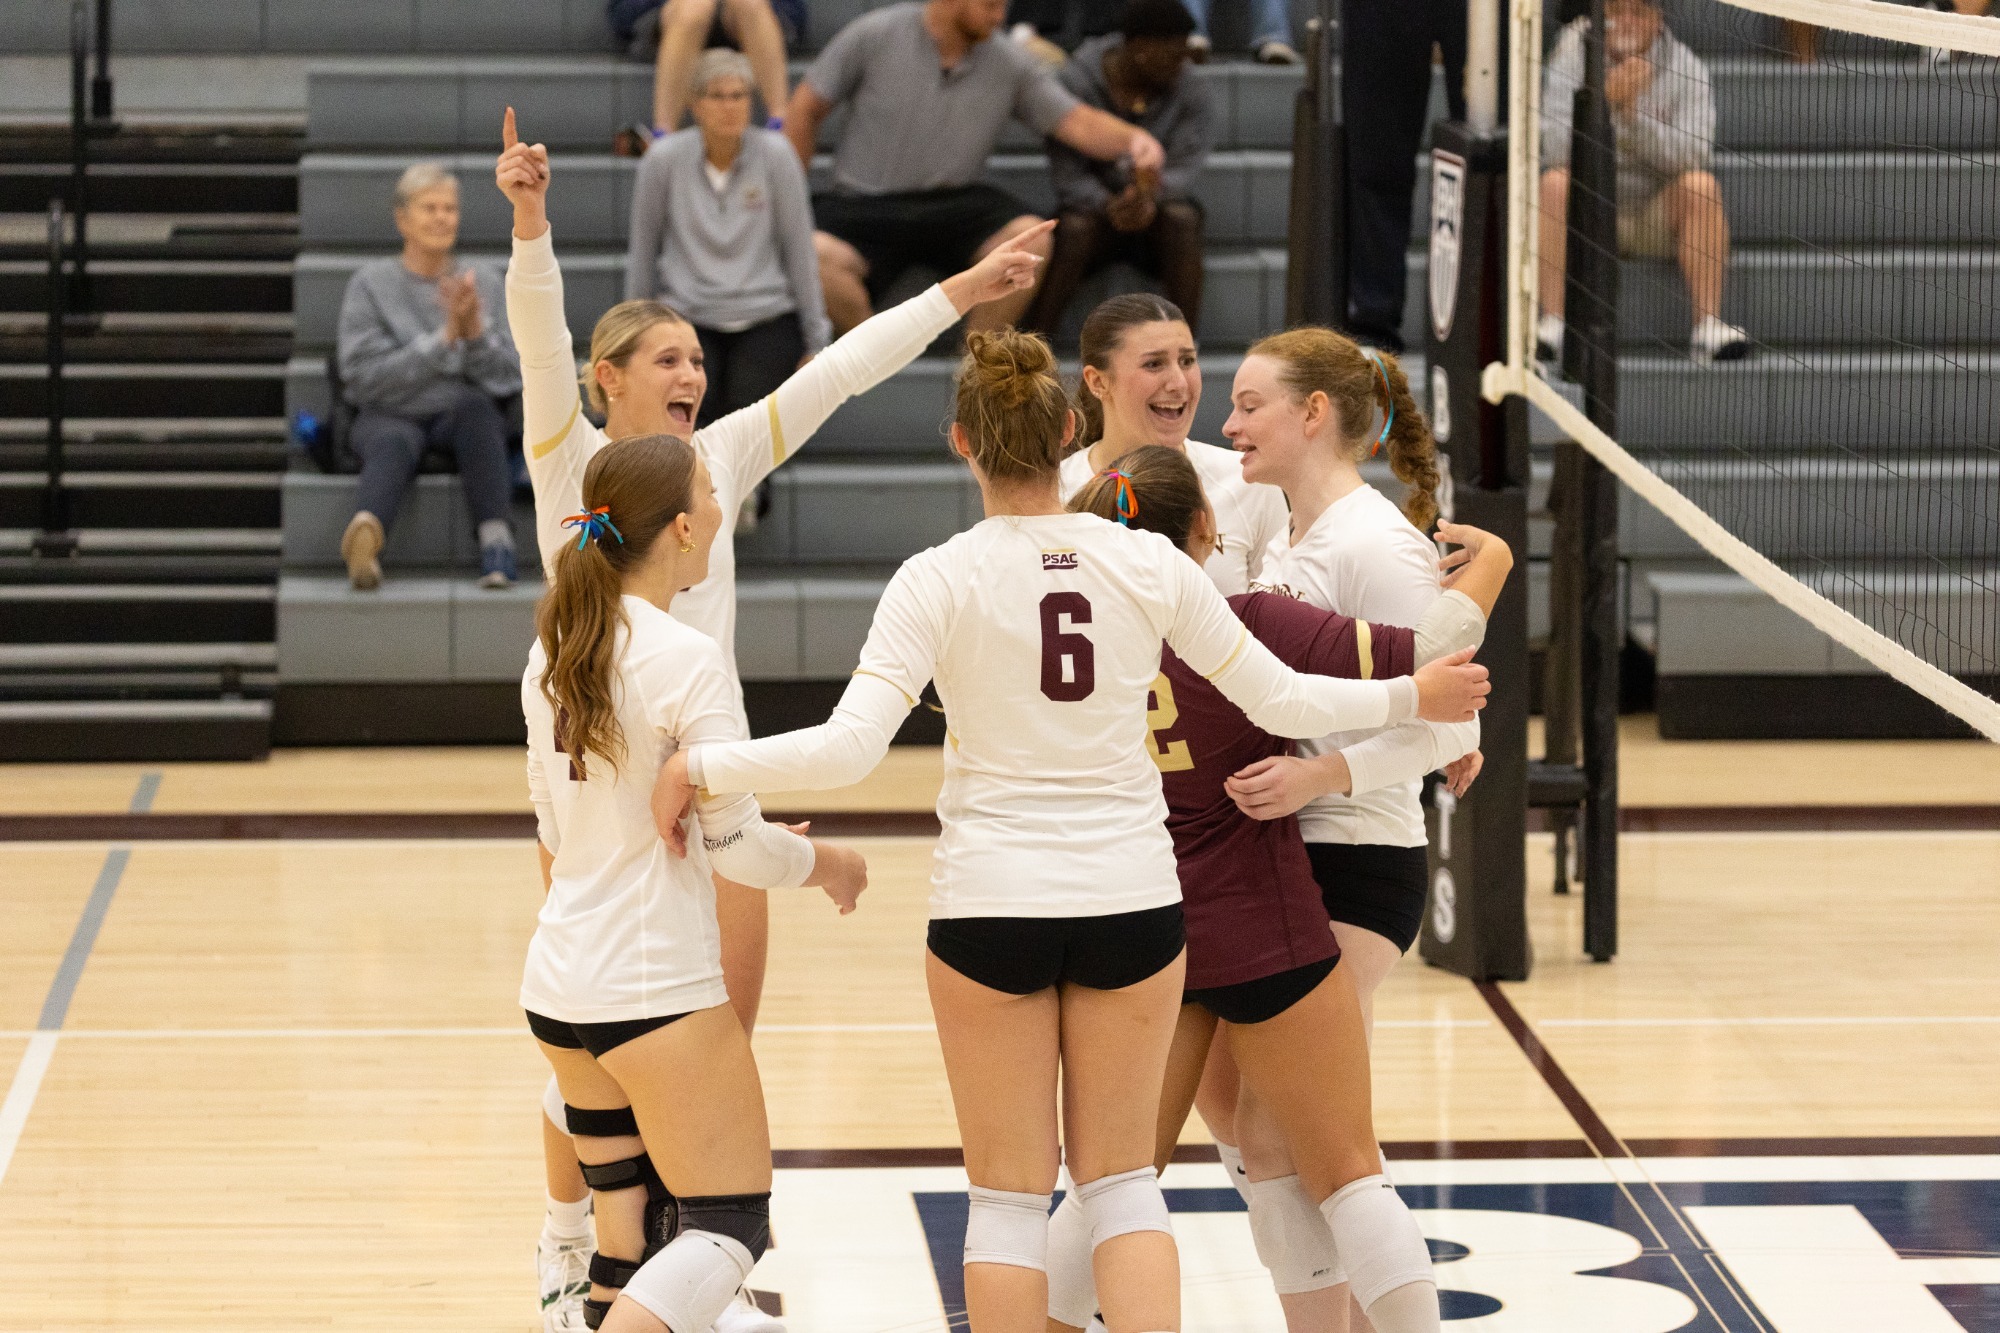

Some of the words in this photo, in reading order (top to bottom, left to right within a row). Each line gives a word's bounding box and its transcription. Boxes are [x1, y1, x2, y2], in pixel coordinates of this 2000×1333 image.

[1042, 552, 1078, 565] PSAC
[1039, 592, 1095, 702] 6
[1145, 670, 1195, 773] 2
